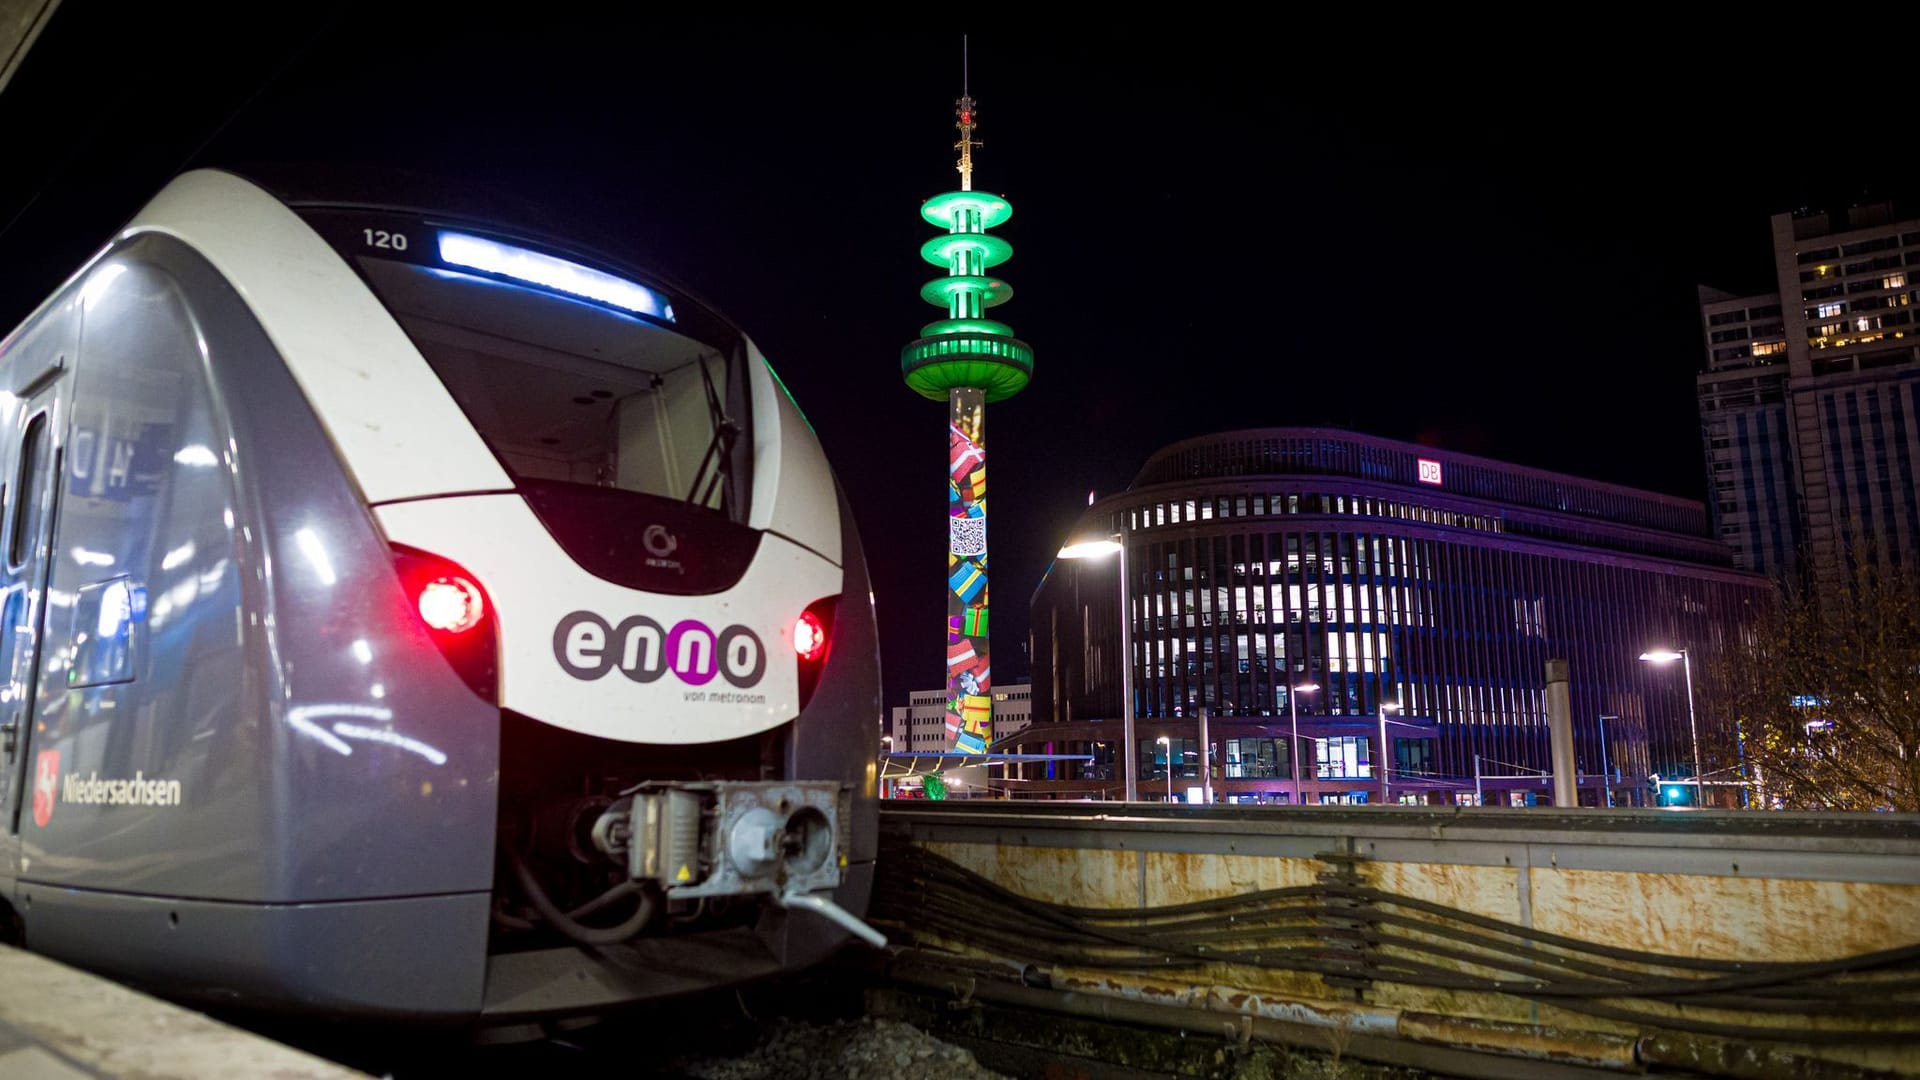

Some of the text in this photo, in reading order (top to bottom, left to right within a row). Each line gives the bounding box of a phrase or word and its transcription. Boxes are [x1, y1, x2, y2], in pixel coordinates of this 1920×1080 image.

[363, 228, 408, 251] 120
[1420, 462, 1440, 481] DB
[564, 620, 758, 679] enno
[683, 691, 766, 704] von metronom
[62, 770, 182, 806] Niedersachsen
